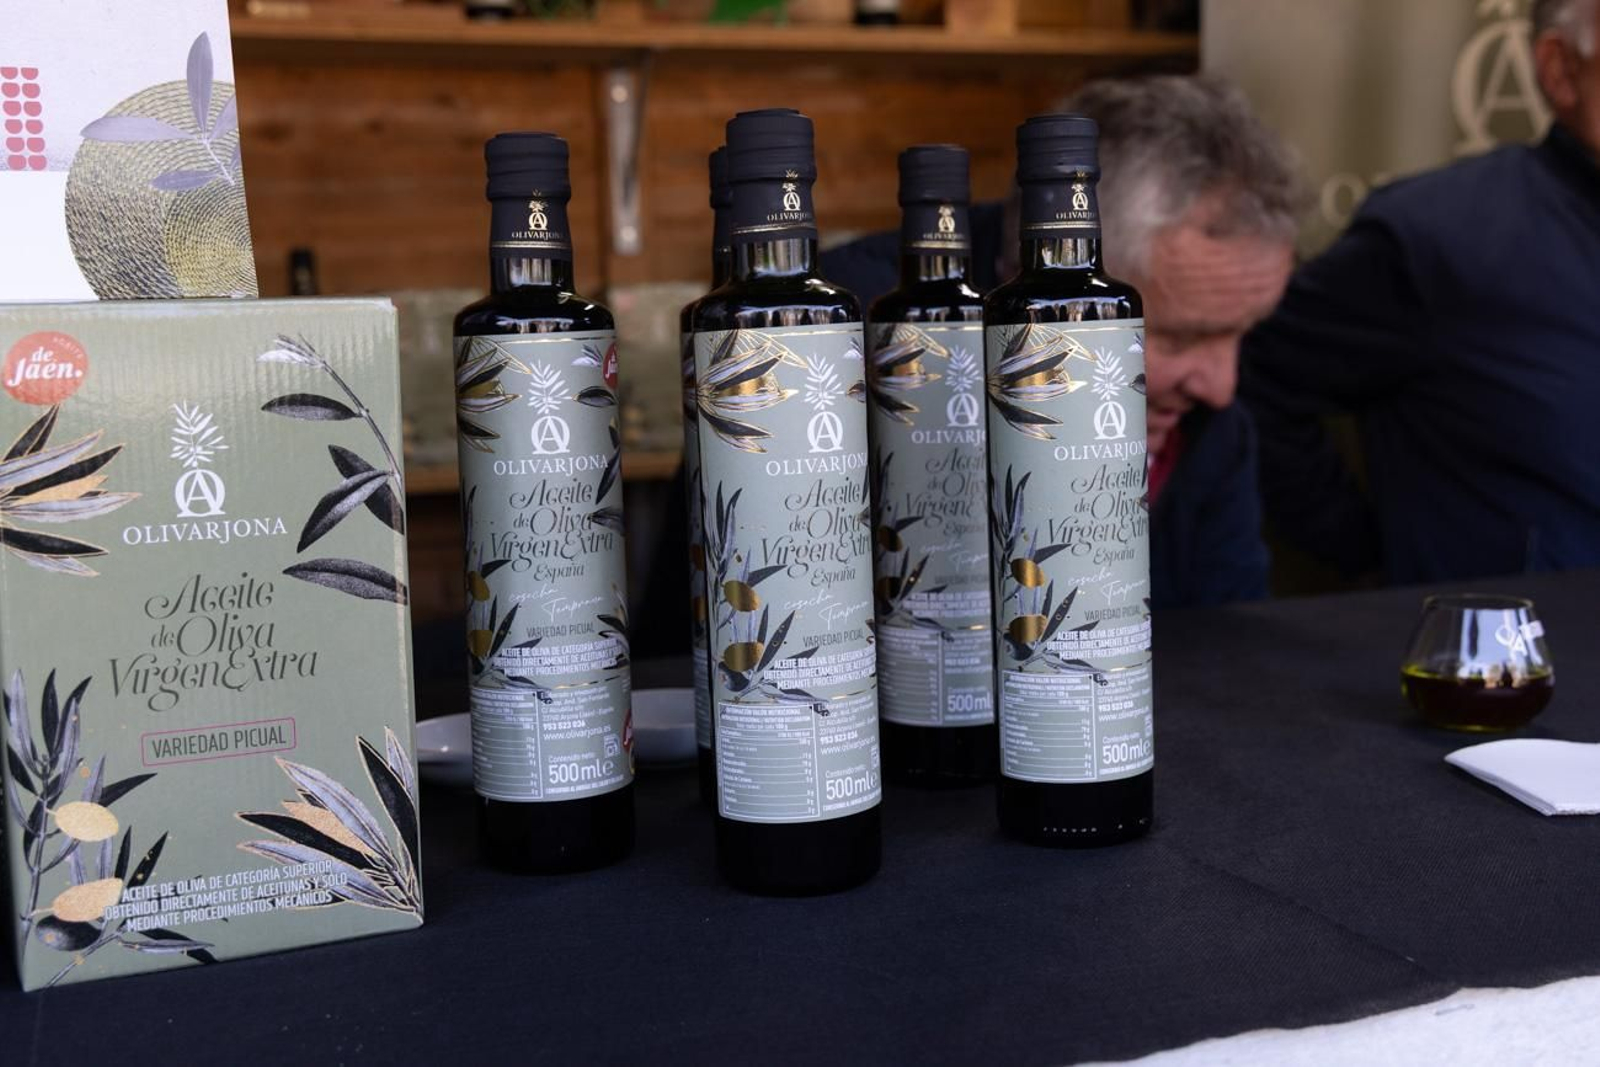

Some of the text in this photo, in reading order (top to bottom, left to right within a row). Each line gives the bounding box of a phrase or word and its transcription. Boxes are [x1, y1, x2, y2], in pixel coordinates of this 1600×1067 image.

[32, 346, 54, 361] de
[493, 455, 608, 476] OLIVARJONA
[1071, 463, 1141, 494] Aceite
[509, 478, 592, 509] Aceite
[785, 477, 860, 511] Aceite
[123, 517, 287, 545] OLIVARJONA
[530, 507, 592, 535] Oliva
[144, 571, 275, 619] Aceite
[526, 622, 595, 638] VARIEDAD PICUAL
[1084, 608, 1121, 621] VARIEDAD
[151, 613, 274, 657] de Oliva
[803, 632, 842, 647] VARIEDAD
[152, 726, 286, 758] VARIEDAD PICUAL
[105, 872, 347, 920] OBTENIDO DIRECTAMENTE DE ACEITUNAS Y SOLO
[121, 885, 158, 902] ACEITE
[160, 882, 175, 897] DE
[177, 878, 207, 894] OLIVA
[209, 876, 222, 889] DE
[283, 861, 332, 878] SUPERIOR
[126, 911, 180, 932] MEDIANTE
[183, 897, 273, 925] PROCEDIMIENTOS
